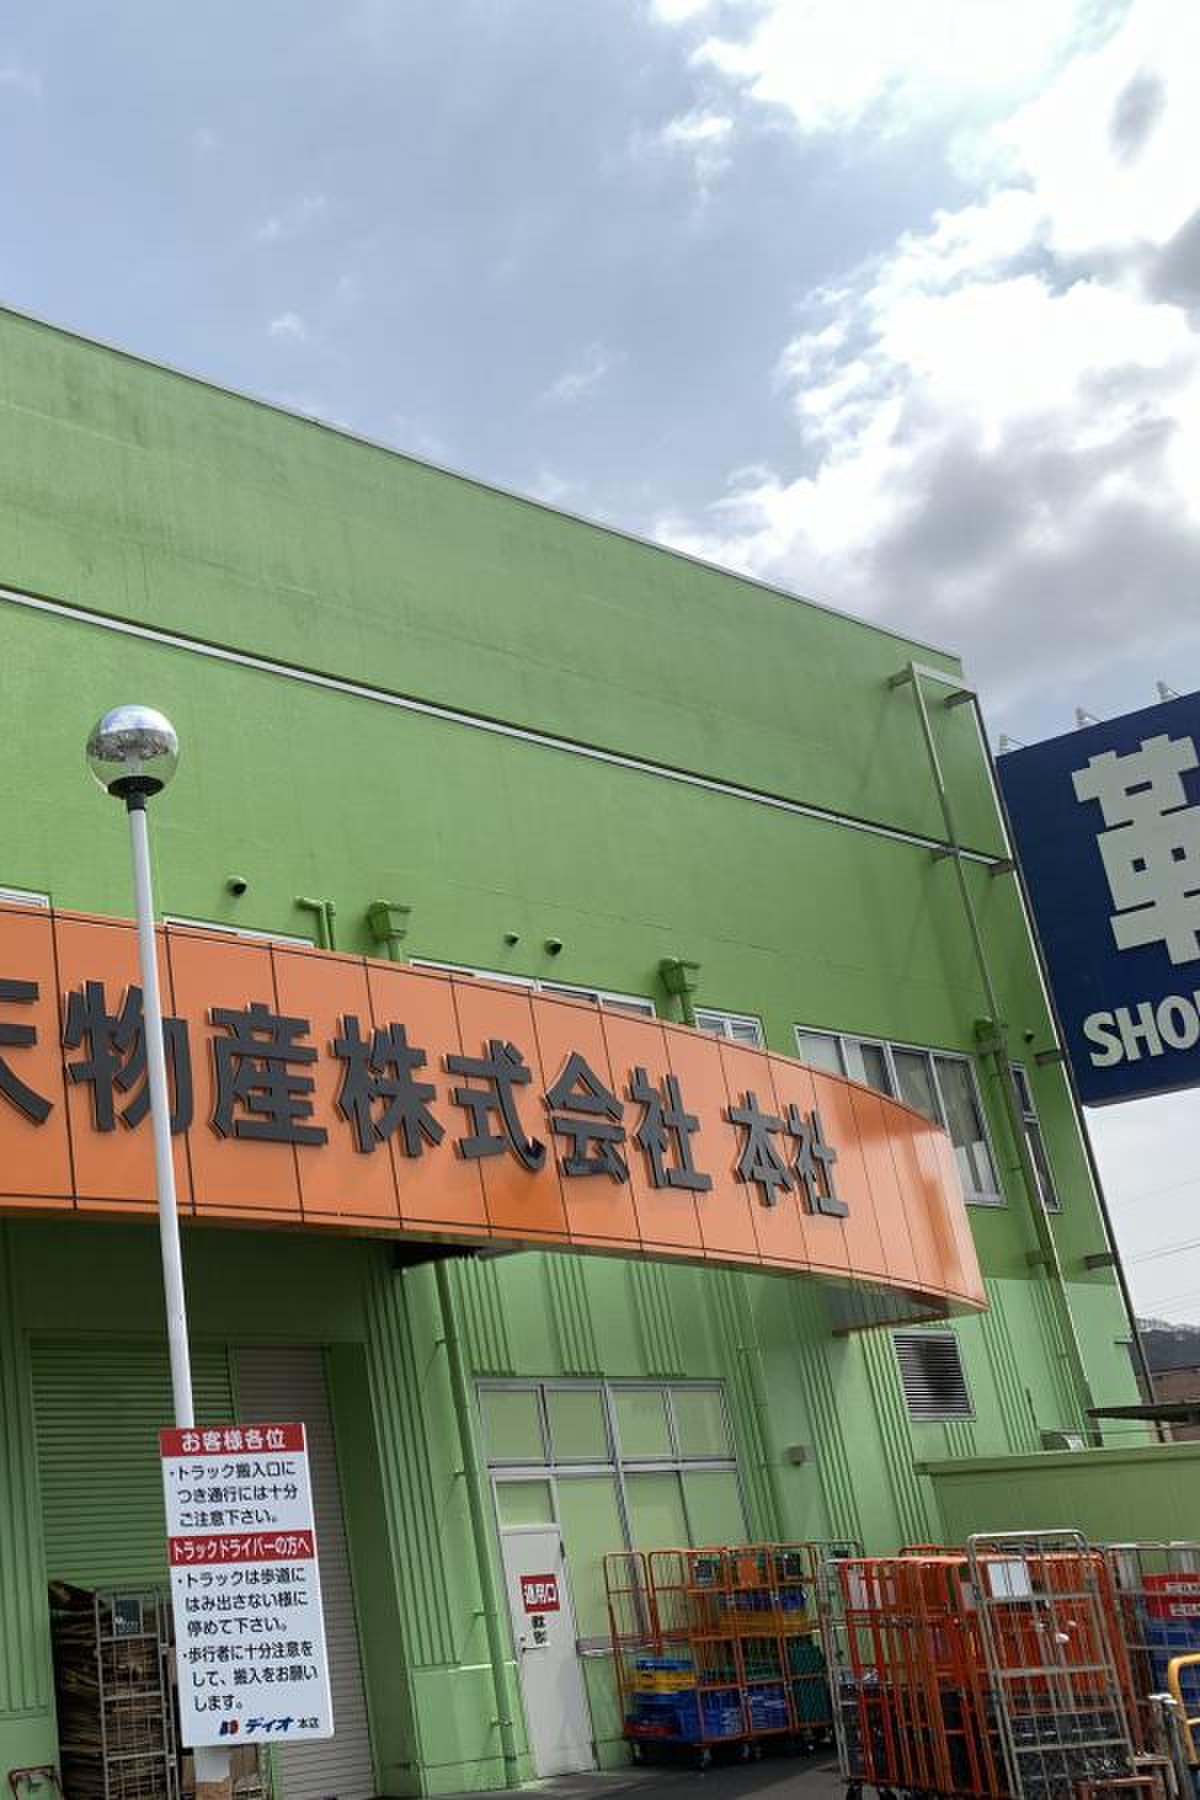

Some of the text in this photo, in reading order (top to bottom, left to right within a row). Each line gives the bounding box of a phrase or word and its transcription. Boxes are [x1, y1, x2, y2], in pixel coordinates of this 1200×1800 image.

[1083, 990, 1200, 1067] SHO
[725, 1091, 849, 1218] 本社
[181, 1428, 286, 1452] お客様各位
[177, 1485, 298, 1504] つき通行には十分
[180, 1509, 277, 1527] ご注意下さい。
[174, 1536, 311, 1561] トラックドライバーの方へ
[186, 1591, 308, 1612] はみ出さない様に
[187, 1618, 287, 1637] 停めて下さい。
[195, 1695, 243, 1712] します。
[245, 1717, 294, 1734] ディオ
